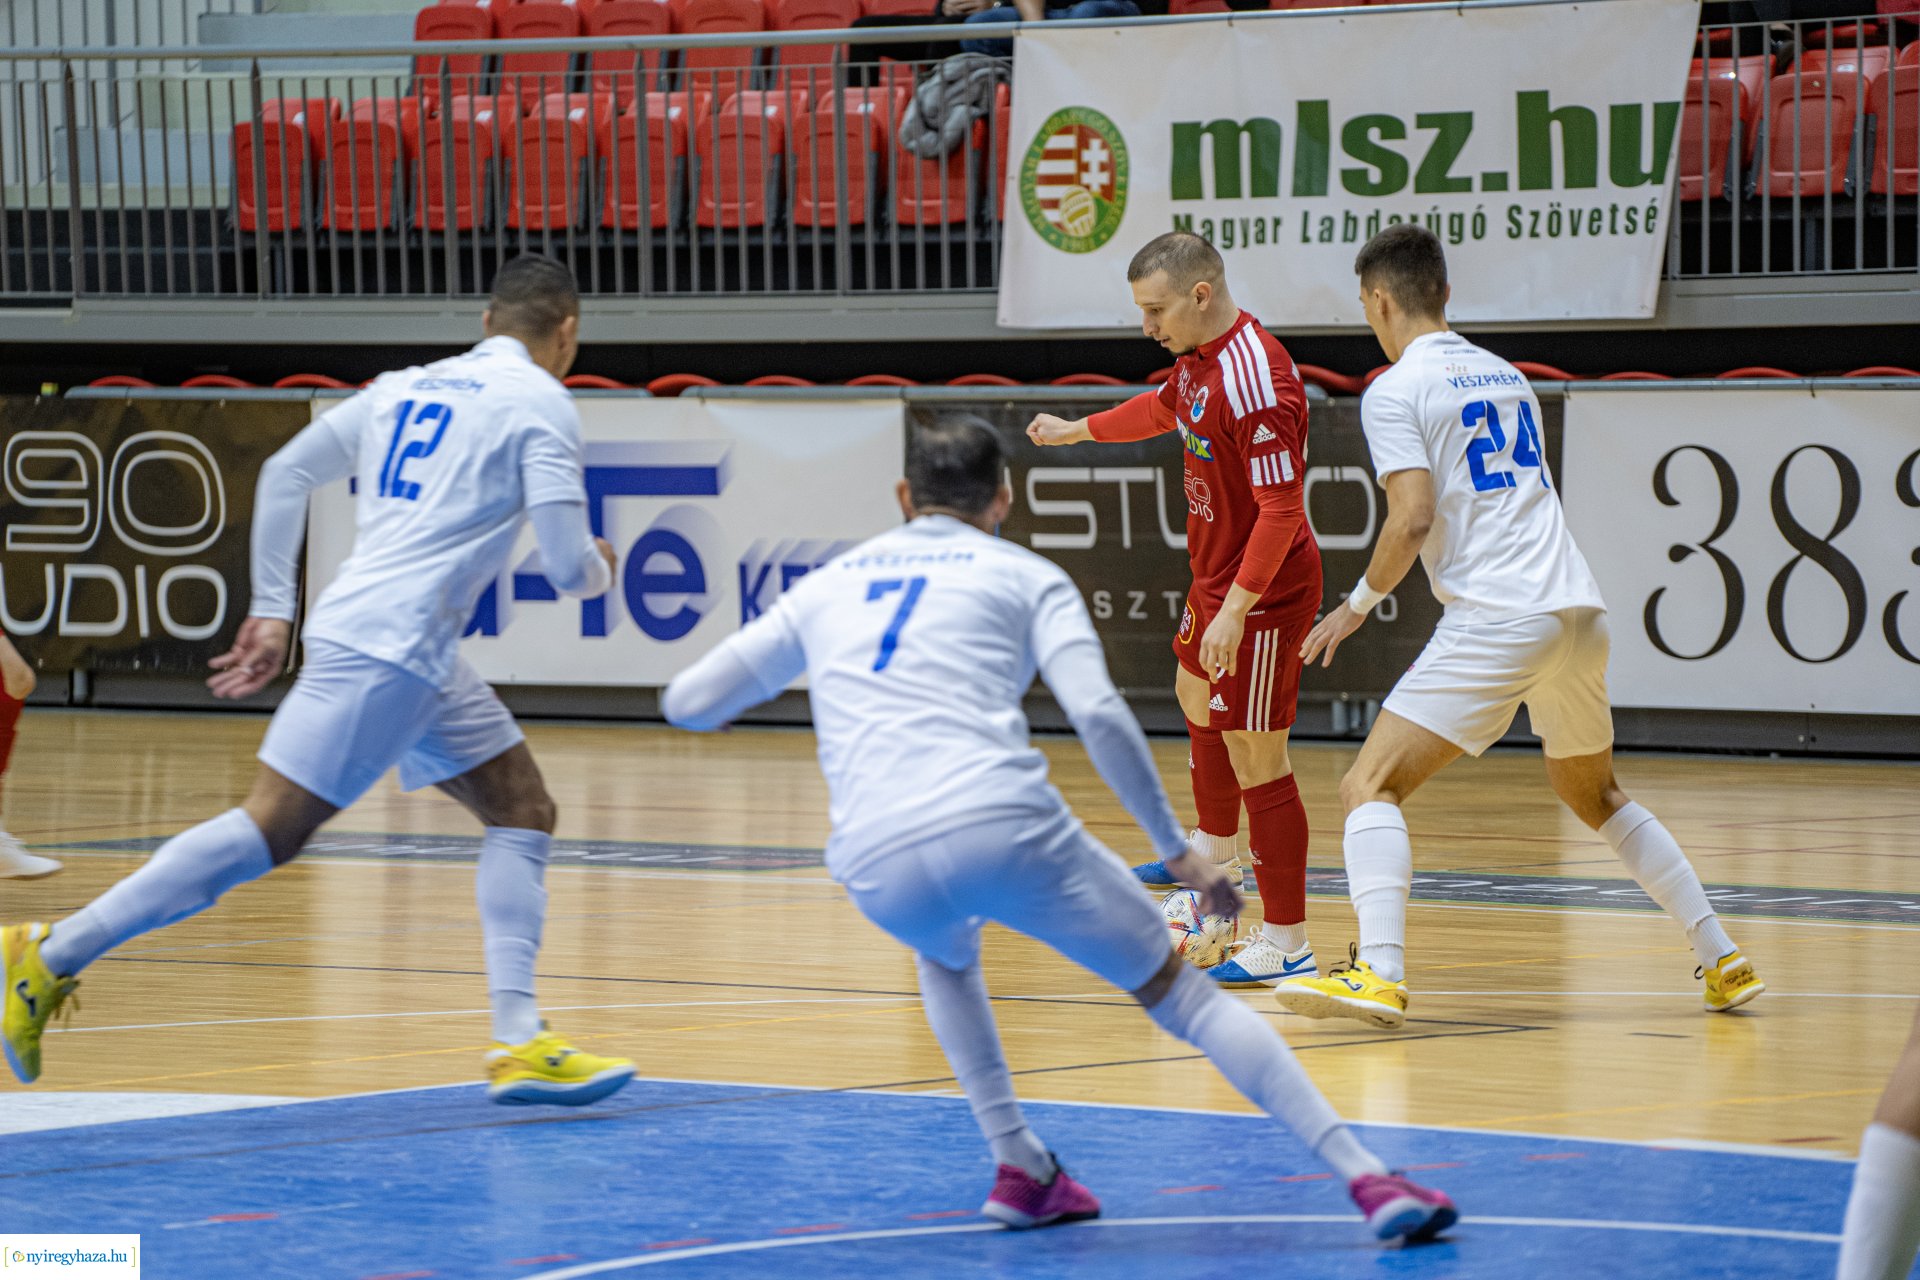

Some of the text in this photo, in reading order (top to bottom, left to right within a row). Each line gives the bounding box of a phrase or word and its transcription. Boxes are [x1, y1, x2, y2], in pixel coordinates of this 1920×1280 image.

[1171, 89, 1682, 201] mlsz.hu
[1173, 213, 1282, 249] Magyar
[1447, 369, 1523, 389] VESZPRÉM
[380, 400, 453, 501] 12
[1462, 400, 1550, 491] 24
[3, 430, 226, 556] 90
[1026, 466, 1378, 550] STUO
[866, 576, 927, 672] 7
